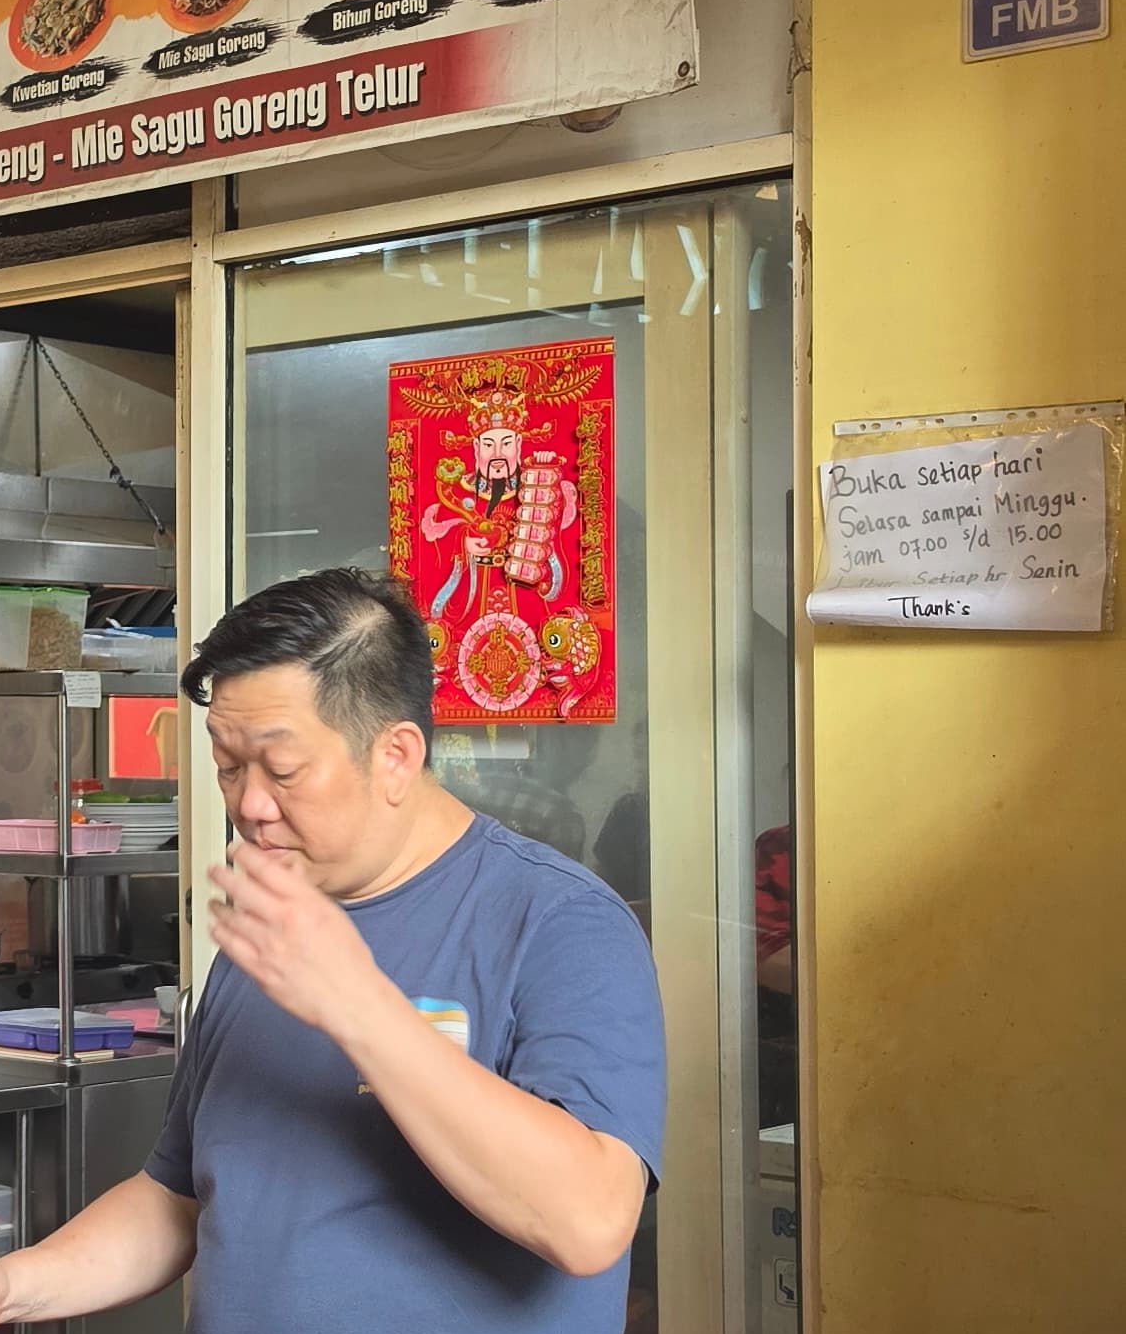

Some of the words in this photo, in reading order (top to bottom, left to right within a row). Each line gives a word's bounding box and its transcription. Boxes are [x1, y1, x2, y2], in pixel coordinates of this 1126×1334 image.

[331, 6, 372, 32] Bihun
[158, 49, 180, 71] Mie
[182, 41, 214, 67] Sagu
[217, 28, 266, 58] Goreng
[12, 78, 60, 104] Kwetiau
[61, 69, 105, 95] Goreng
[71, 118, 124, 169] Mie
[130, 106, 206, 157] Sagu
[213, 80, 327, 141] Goreng
[336, 59, 425, 116] Telur
[829, 465, 907, 499] Buka
[993, 447, 1043, 478] hari
[838, 505, 911, 539] Selasa
[921, 496, 983, 527] sampai
[1008, 522, 1063, 546] 15.00
[1019, 554, 1081, 581] Senin
